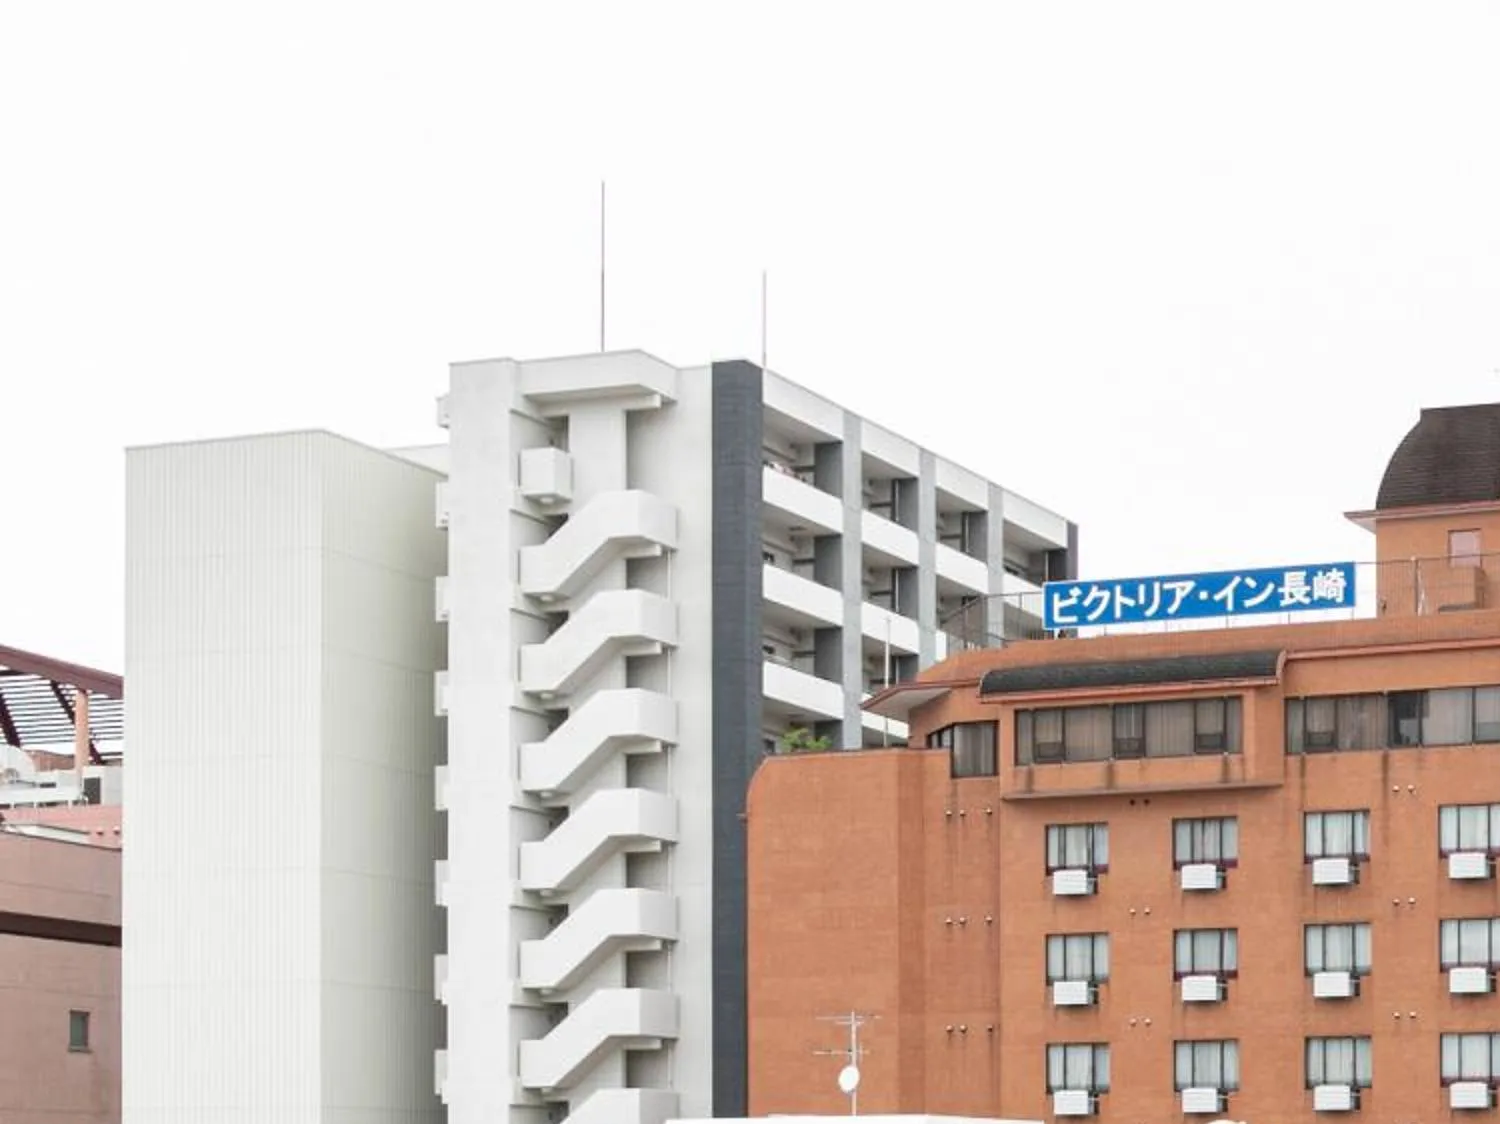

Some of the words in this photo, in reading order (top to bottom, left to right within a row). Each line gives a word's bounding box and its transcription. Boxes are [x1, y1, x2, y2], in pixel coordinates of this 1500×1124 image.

[1052, 568, 1347, 624] ビクトリア・イン長崎
